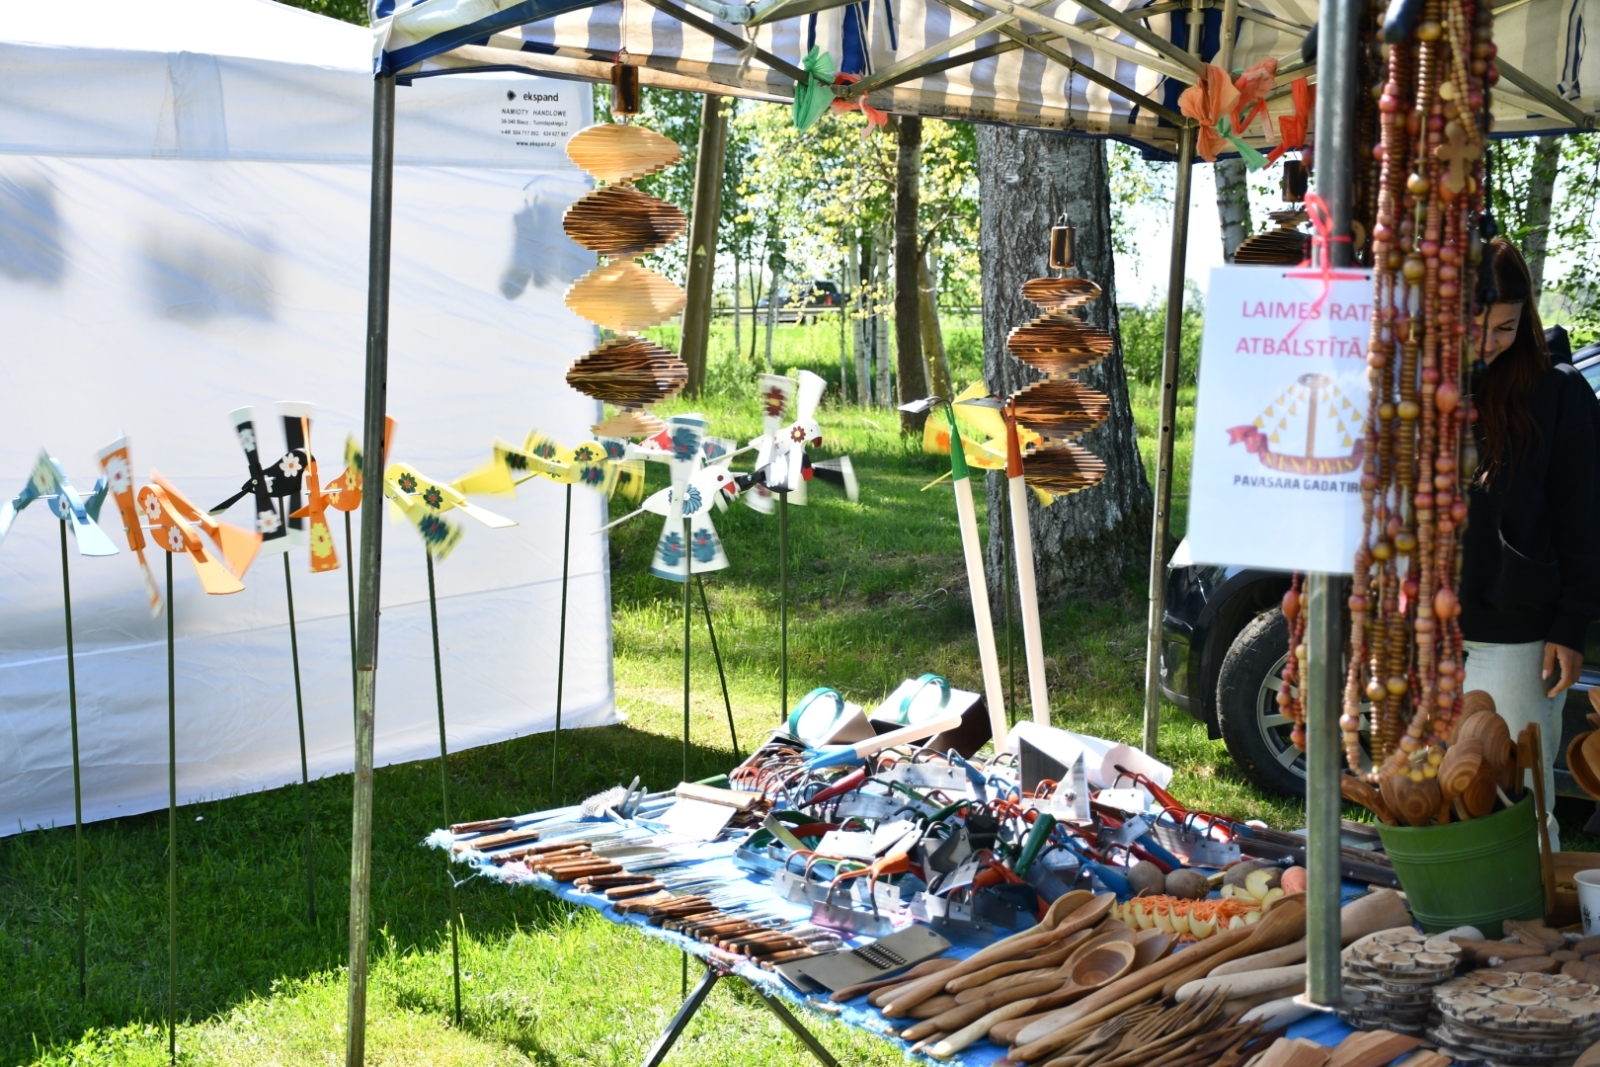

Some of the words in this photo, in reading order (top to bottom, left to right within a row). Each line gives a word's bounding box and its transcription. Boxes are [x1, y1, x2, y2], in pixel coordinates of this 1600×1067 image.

[523, 91, 559, 104] ekspand
[501, 108, 529, 116] NAMIOTY
[533, 109, 567, 117] HANDLOWE
[1241, 301, 1321, 320] LAIMES
[1329, 303, 1372, 322] RAT
[1235, 336, 1368, 359] ATBALSTĪTĀ
[1233, 474, 1300, 490] PAVASARA
